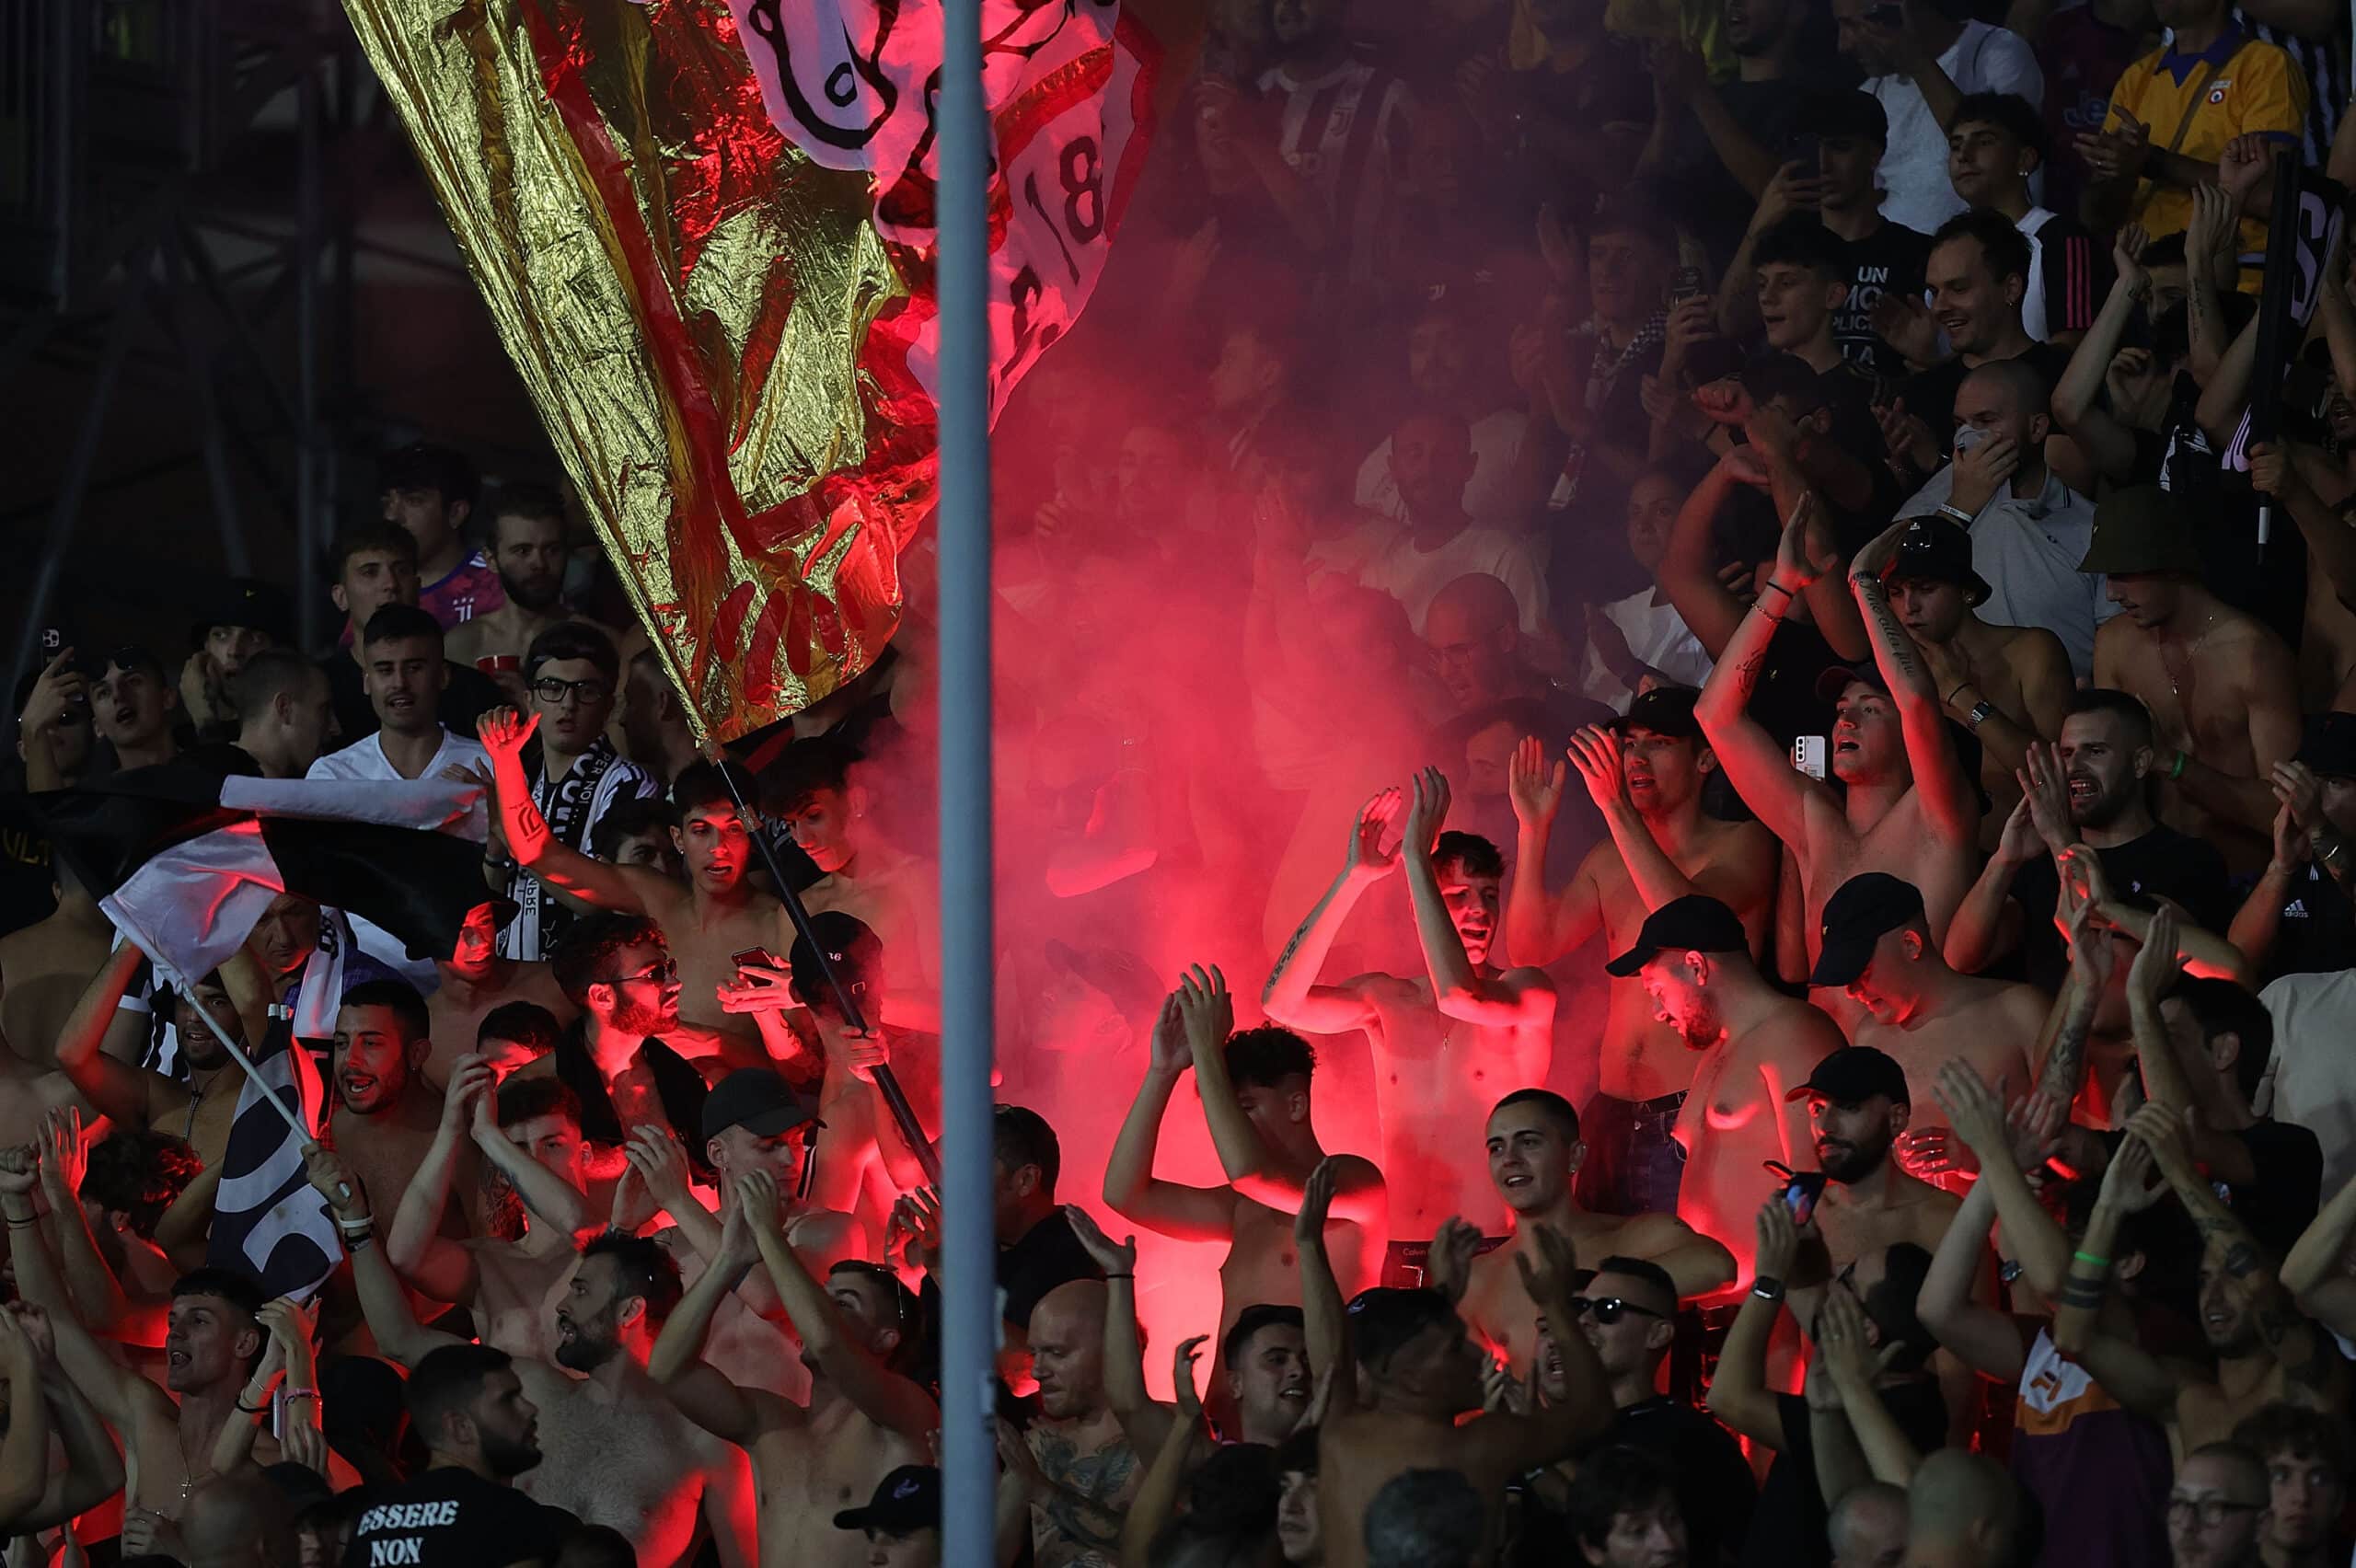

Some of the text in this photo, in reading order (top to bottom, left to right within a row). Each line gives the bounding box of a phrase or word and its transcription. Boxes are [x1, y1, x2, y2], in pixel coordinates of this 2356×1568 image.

[1857, 265, 1889, 283] UN
[590, 751, 612, 775] PER
[2283, 910, 2310, 918] adidas
[356, 1499, 461, 1538] ESSERE
[368, 1535, 425, 1568] NON
